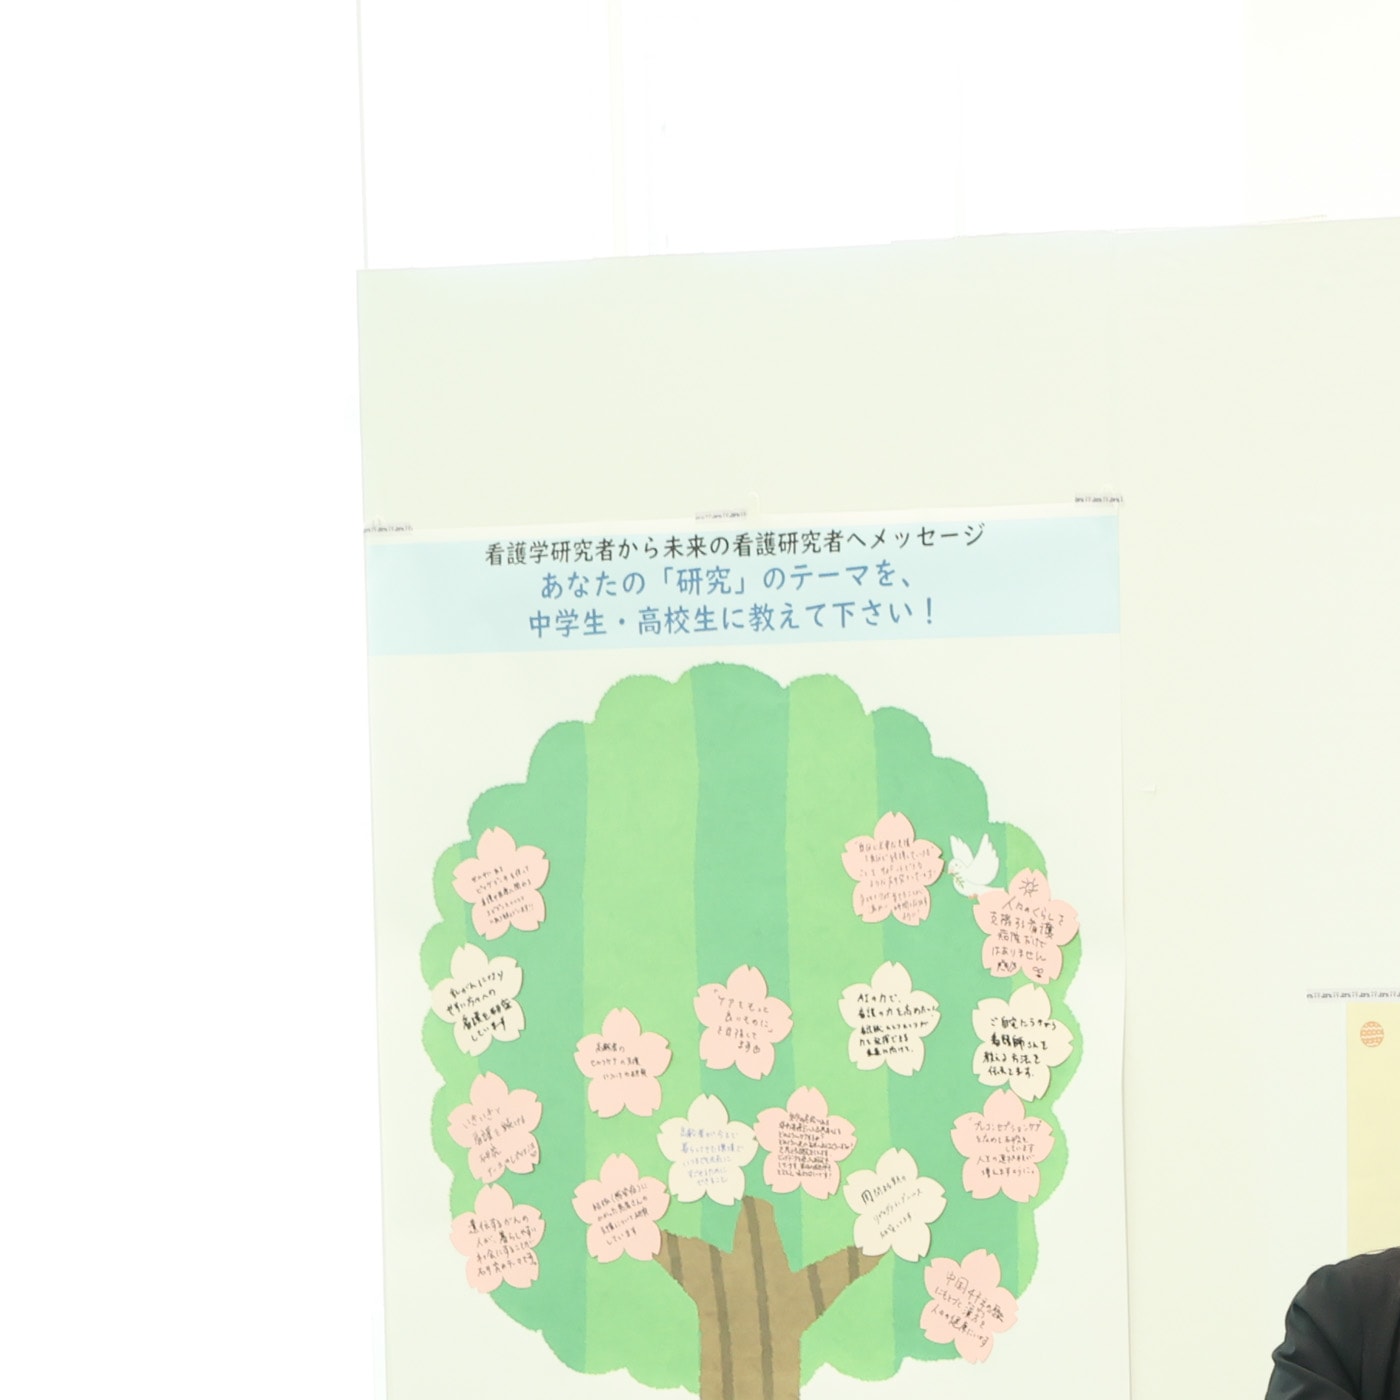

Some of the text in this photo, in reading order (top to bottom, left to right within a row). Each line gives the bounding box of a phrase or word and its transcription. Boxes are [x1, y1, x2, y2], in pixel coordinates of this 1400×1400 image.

[485, 522, 986, 566] 看護学研究者から未来の看護研究者へメッセージ
[540, 562, 912, 601] あなたの「研究」のテーマを、
[528, 597, 936, 639] 中学生・高校生に教えて下さい!
